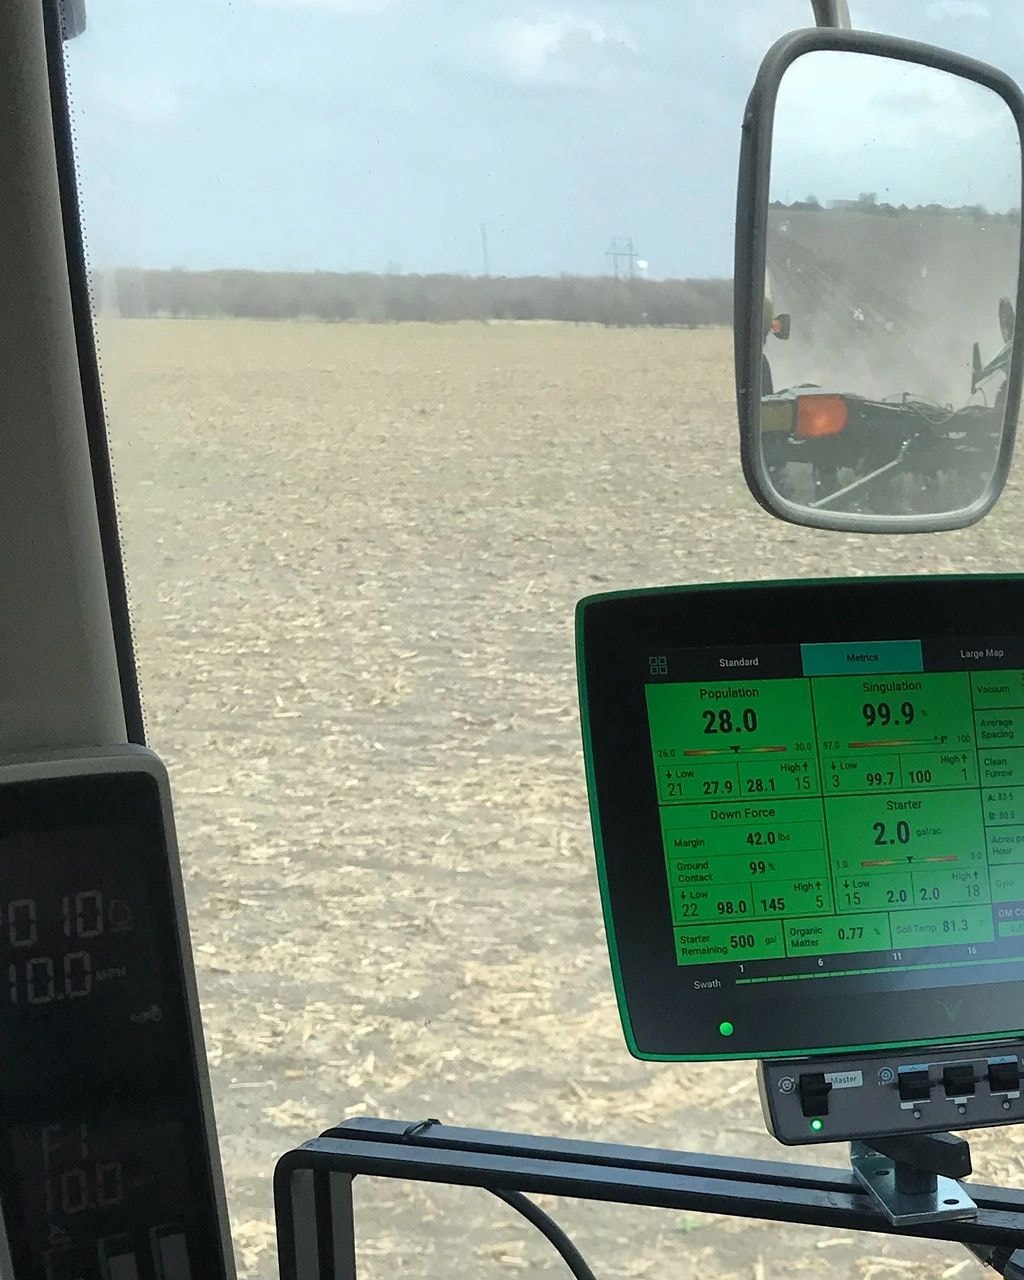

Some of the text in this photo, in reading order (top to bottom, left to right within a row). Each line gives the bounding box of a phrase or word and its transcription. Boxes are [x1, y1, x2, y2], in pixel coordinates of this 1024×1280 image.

[847, 653, 879, 663] Metrics
[961, 648, 1004, 660] Large Map
[719, 657, 759, 668] Standard
[863, 681, 922, 694] Singulation
[977, 685, 1010, 694] Vacuum
[700, 687, 759, 701] Population
[862, 701, 915, 727] 99.9
[702, 708, 757, 734] 28.0
[980, 719, 1013, 729] Average
[957, 734, 971, 744] 100
[981, 730, 1014, 740] Spacing
[658, 747, 675, 758] 26.0
[840, 761, 858, 770] Low
[941, 755, 960, 766] High
[984, 758, 1007, 766] Clean
[676, 768, 694, 778] Low
[780, 763, 800, 774] High
[985, 769, 1013, 778] Furrow
[866, 772, 894, 786] 99.7
[908, 770, 932, 784] 100
[961, 768, 968, 781] 1
[747, 778, 776, 792] 28.1
[795, 776, 811, 790] 15
[832, 775, 840, 788] 3
[667, 783, 683, 797] 21
[703, 780, 733, 795] 27.9
[887, 800, 923, 811] Starter
[710, 808, 776, 821] Down Force
[746, 831, 791, 846] 42.0 lbs
[872, 820, 942, 846] 2.0 gal/ac
[674, 838, 705, 849] Margin
[992, 847, 1012, 856] Hour
[676, 861, 709, 871] Ground
[749, 861, 766, 875] 99
[678, 873, 713, 883] Contact
[952, 871, 971, 882] High
[793, 882, 814, 893] High
[852, 878, 870, 888] Low
[690, 890, 708, 899] Low
[886, 889, 907, 904] 2.0
[920, 887, 940, 901] 2.0
[966, 884, 980, 898] 18
[816, 895, 824, 908] 5
[846, 892, 861, 905] 15
[682, 903, 699, 917] 22
[717, 900, 747, 915] 98.0
[761, 897, 785, 912] 145
[998, 909, 1013, 918] OM
[943, 920, 969, 932] 81.3
[789, 927, 822, 937] Organic
[838, 926, 864, 940] 0.77
[680, 934, 710, 944] Starter
[730, 934, 755, 949] 500
[791, 938, 819, 948] Matter
[682, 945, 728, 957] Remaining
[893, 952, 902, 961] 11
[818, 958, 824, 967] 6
[96, 966, 127, 982] MPH
[739, 964, 745, 973] 1
[693, 979, 721, 990] Swath
[831, 1075, 857, 1086] Master
